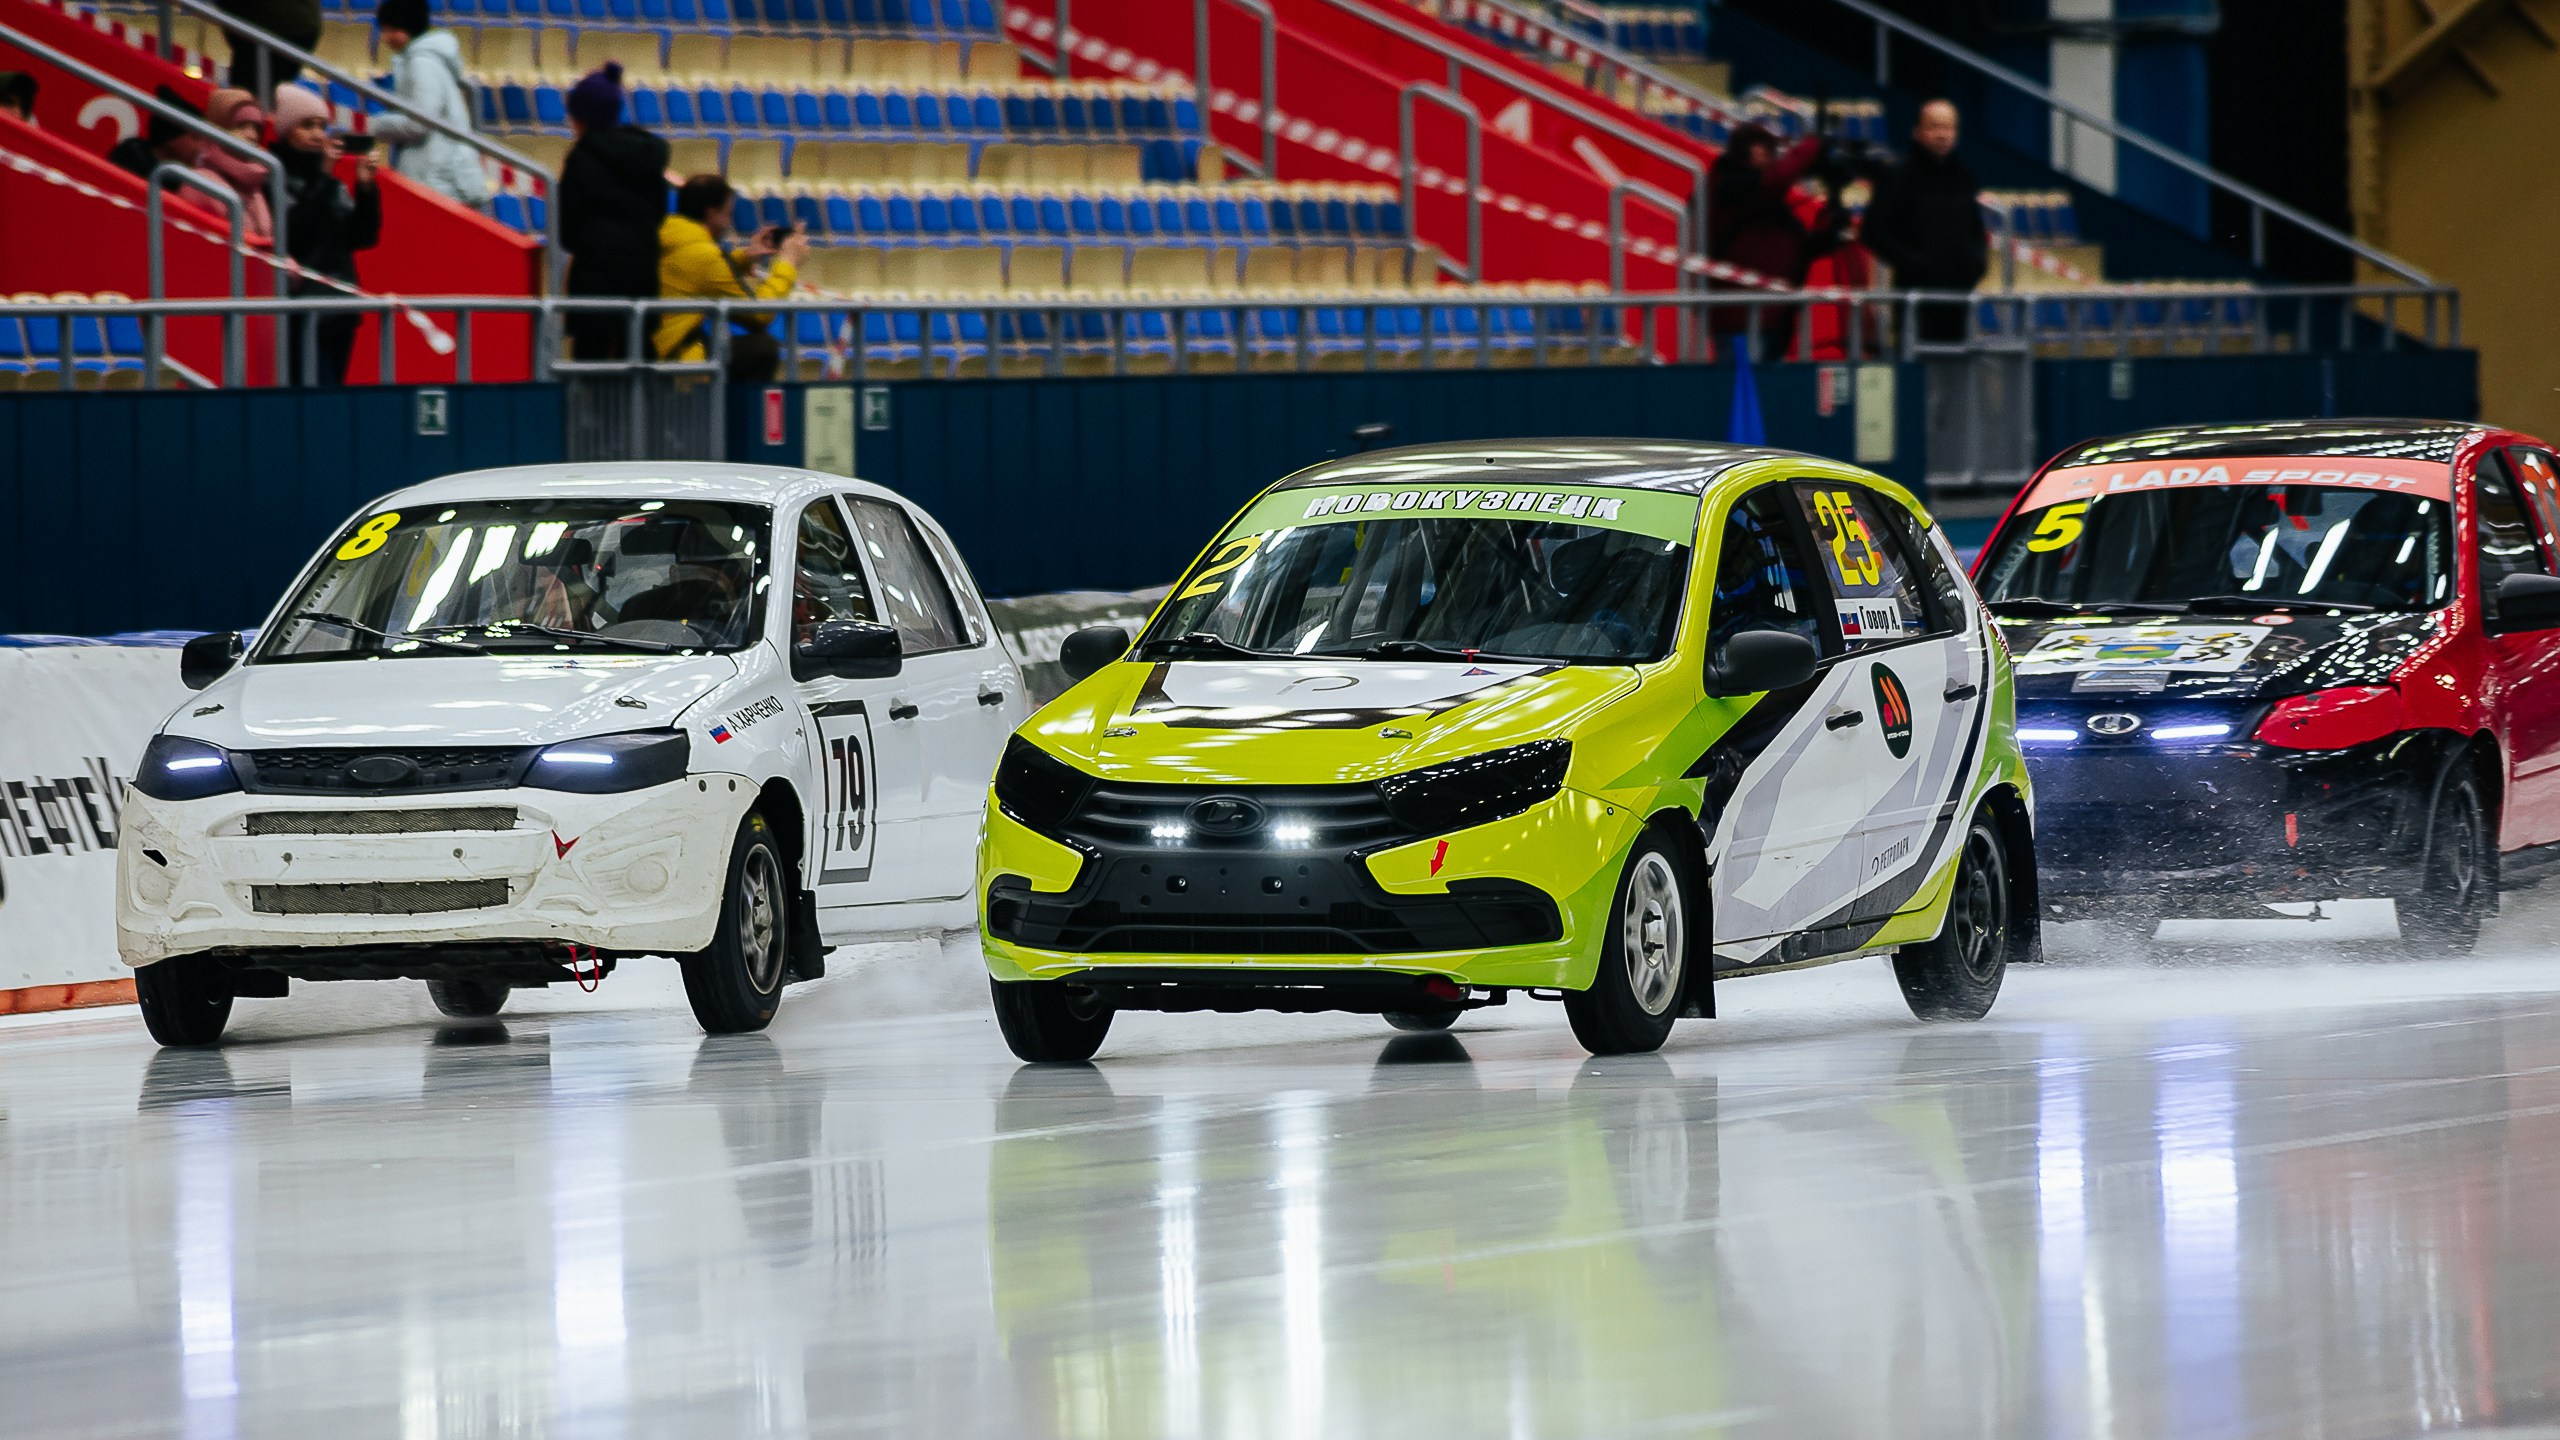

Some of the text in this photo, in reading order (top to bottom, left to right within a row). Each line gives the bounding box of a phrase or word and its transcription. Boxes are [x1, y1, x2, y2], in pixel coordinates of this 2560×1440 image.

[2108, 466, 2417, 492] LADA SPORT
[1302, 490, 1627, 522] НОВОКУЗНЕЦК
[2026, 502, 2089, 553] 5
[336, 512, 402, 561] 8
[1813, 490, 1881, 587] 25
[1176, 535, 1264, 602] 2
[1858, 605, 1901, 635] Говор А.
[726, 694, 785, 733] А.ХАРЧЕНКО
[830, 734, 866, 852] 79
